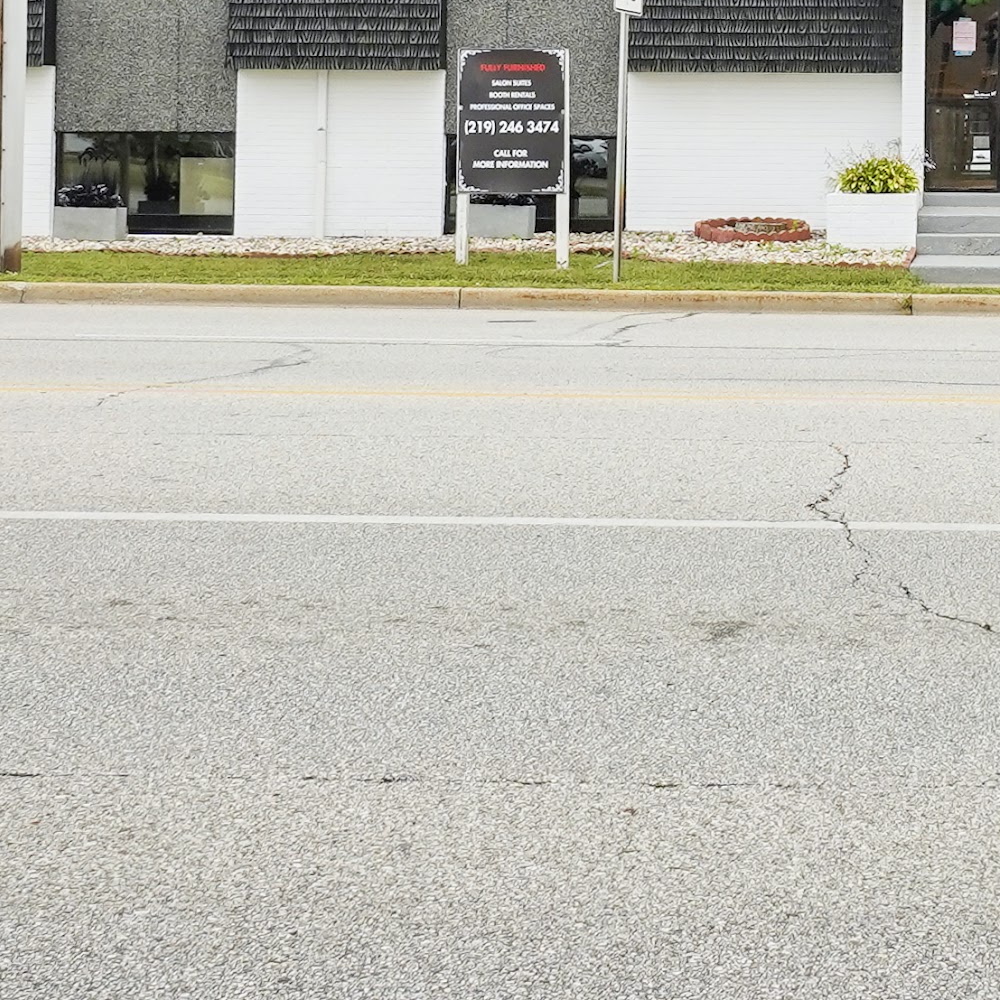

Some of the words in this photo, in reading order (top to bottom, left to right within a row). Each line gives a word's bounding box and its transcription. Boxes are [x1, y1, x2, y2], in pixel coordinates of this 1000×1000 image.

[480, 63, 501, 71] FULLY
[503, 63, 546, 72] FURNISHED
[491, 79, 512, 87] SALON
[512, 79, 532, 87] SUITES
[489, 91, 510, 99] BOOTH
[510, 91, 536, 99] RENTALS
[469, 103, 512, 111] PROFESSIONAL
[512, 103, 533, 111] OFFICE
[533, 103, 556, 111] SPACES
[464, 119, 496, 135] (219)
[499, 120, 524, 134] 246
[526, 120, 560, 134] 3474
[493, 149, 511, 158] CALL
[512, 149, 528, 158] FOR
[472, 160, 495, 169] MORE
[496, 160, 549, 169] INFORMATION
